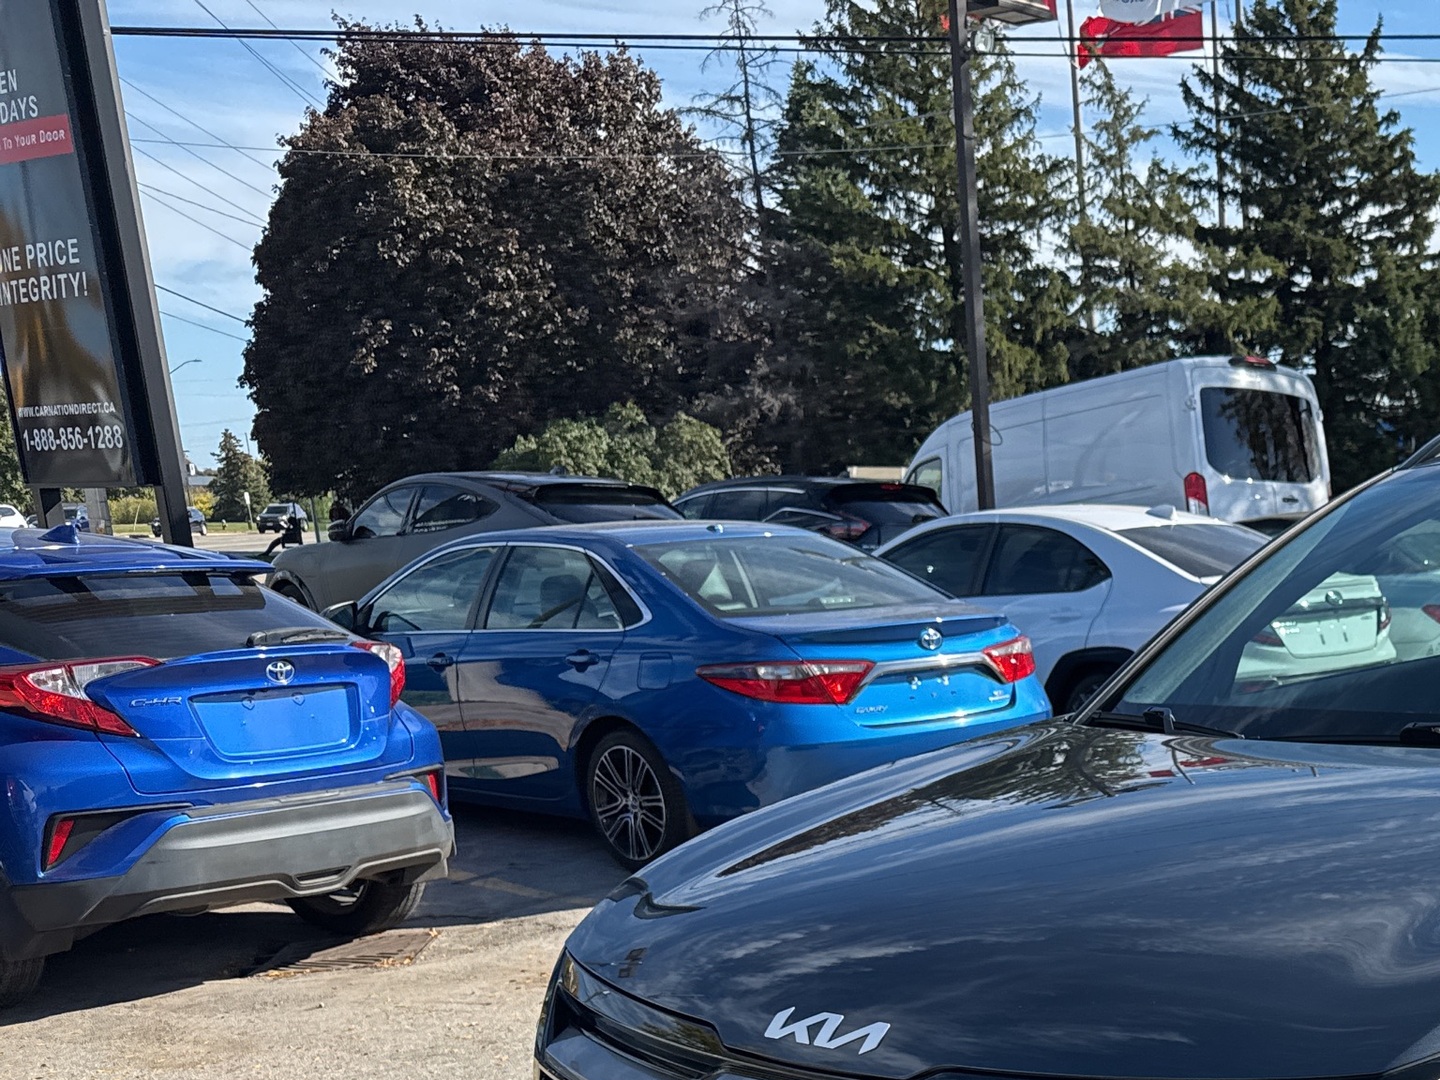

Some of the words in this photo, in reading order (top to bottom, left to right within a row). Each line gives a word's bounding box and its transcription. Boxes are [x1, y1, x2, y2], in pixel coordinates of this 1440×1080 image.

[0, 95, 39, 124] DAYS
[25, 238, 80, 270] PRICE
[23, 424, 124, 452] 1-888-856-1288
